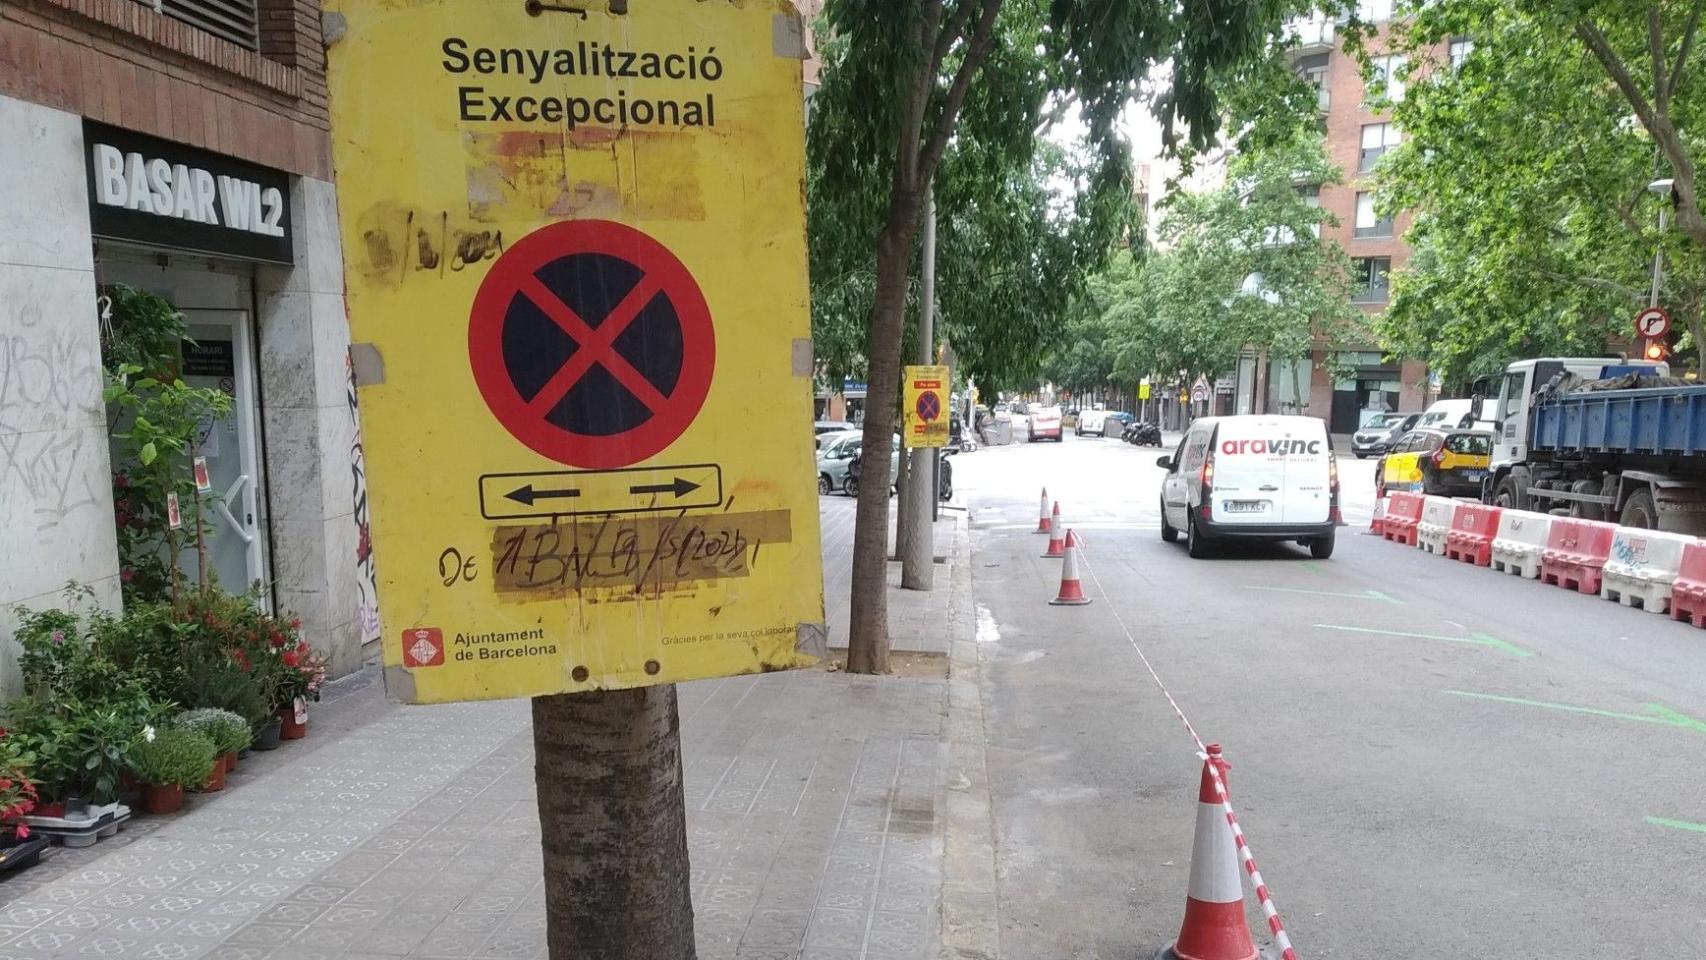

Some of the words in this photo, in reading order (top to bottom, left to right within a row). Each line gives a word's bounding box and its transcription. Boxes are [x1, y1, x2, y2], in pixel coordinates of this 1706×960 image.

[441, 37, 723, 84] Senyalització
[458, 86, 715, 130] Excepcional
[93, 143, 219, 225] BASAR
[218, 174, 285, 237] WL2
[455, 628, 544, 647] Ajuntament
[455, 649, 474, 661] de
[479, 645, 557, 660] Barcelona
[699, 633, 713, 645] per
[716, 632, 725, 640] la
